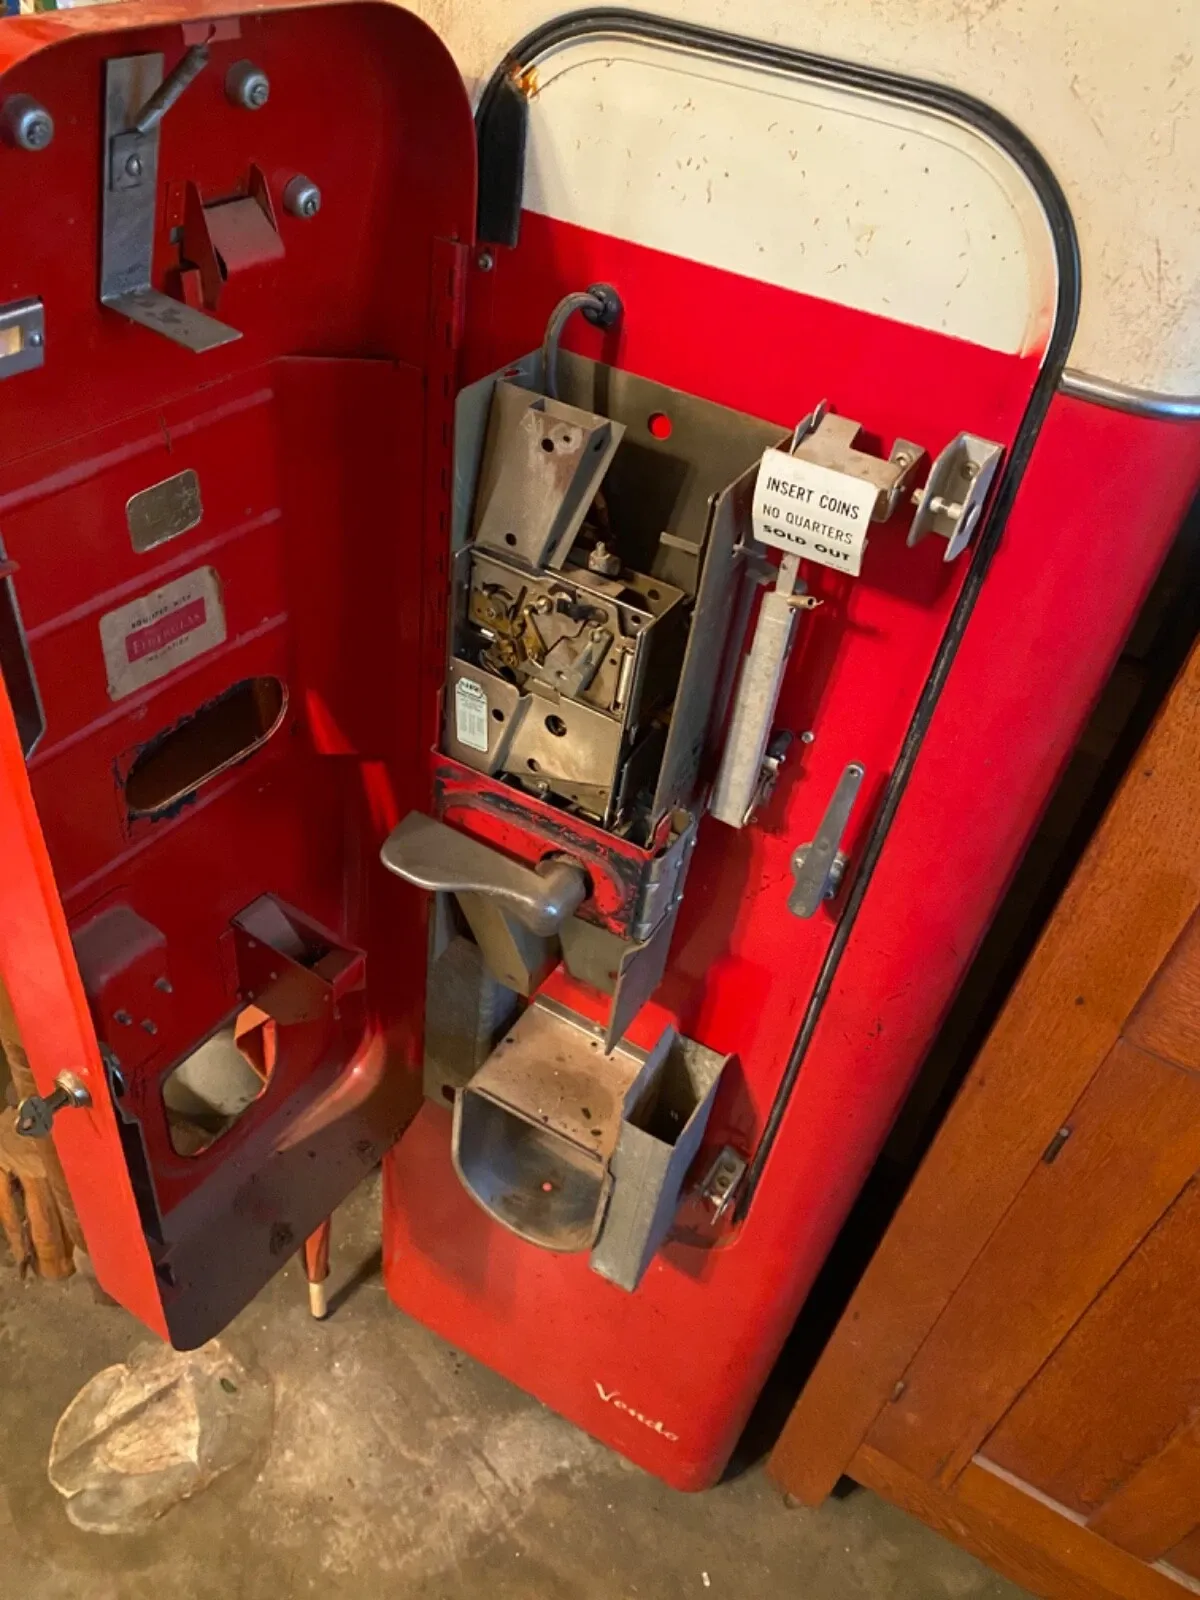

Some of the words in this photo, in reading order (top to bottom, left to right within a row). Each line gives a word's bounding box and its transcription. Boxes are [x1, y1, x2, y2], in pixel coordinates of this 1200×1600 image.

[766, 476, 814, 504] INSERT
[819, 494, 860, 520] COINS
[762, 503, 780, 519] NO
[785, 511, 853, 545] QUARTERS
[762, 524, 807, 546] SOLD
[814, 543, 850, 561] OUT
